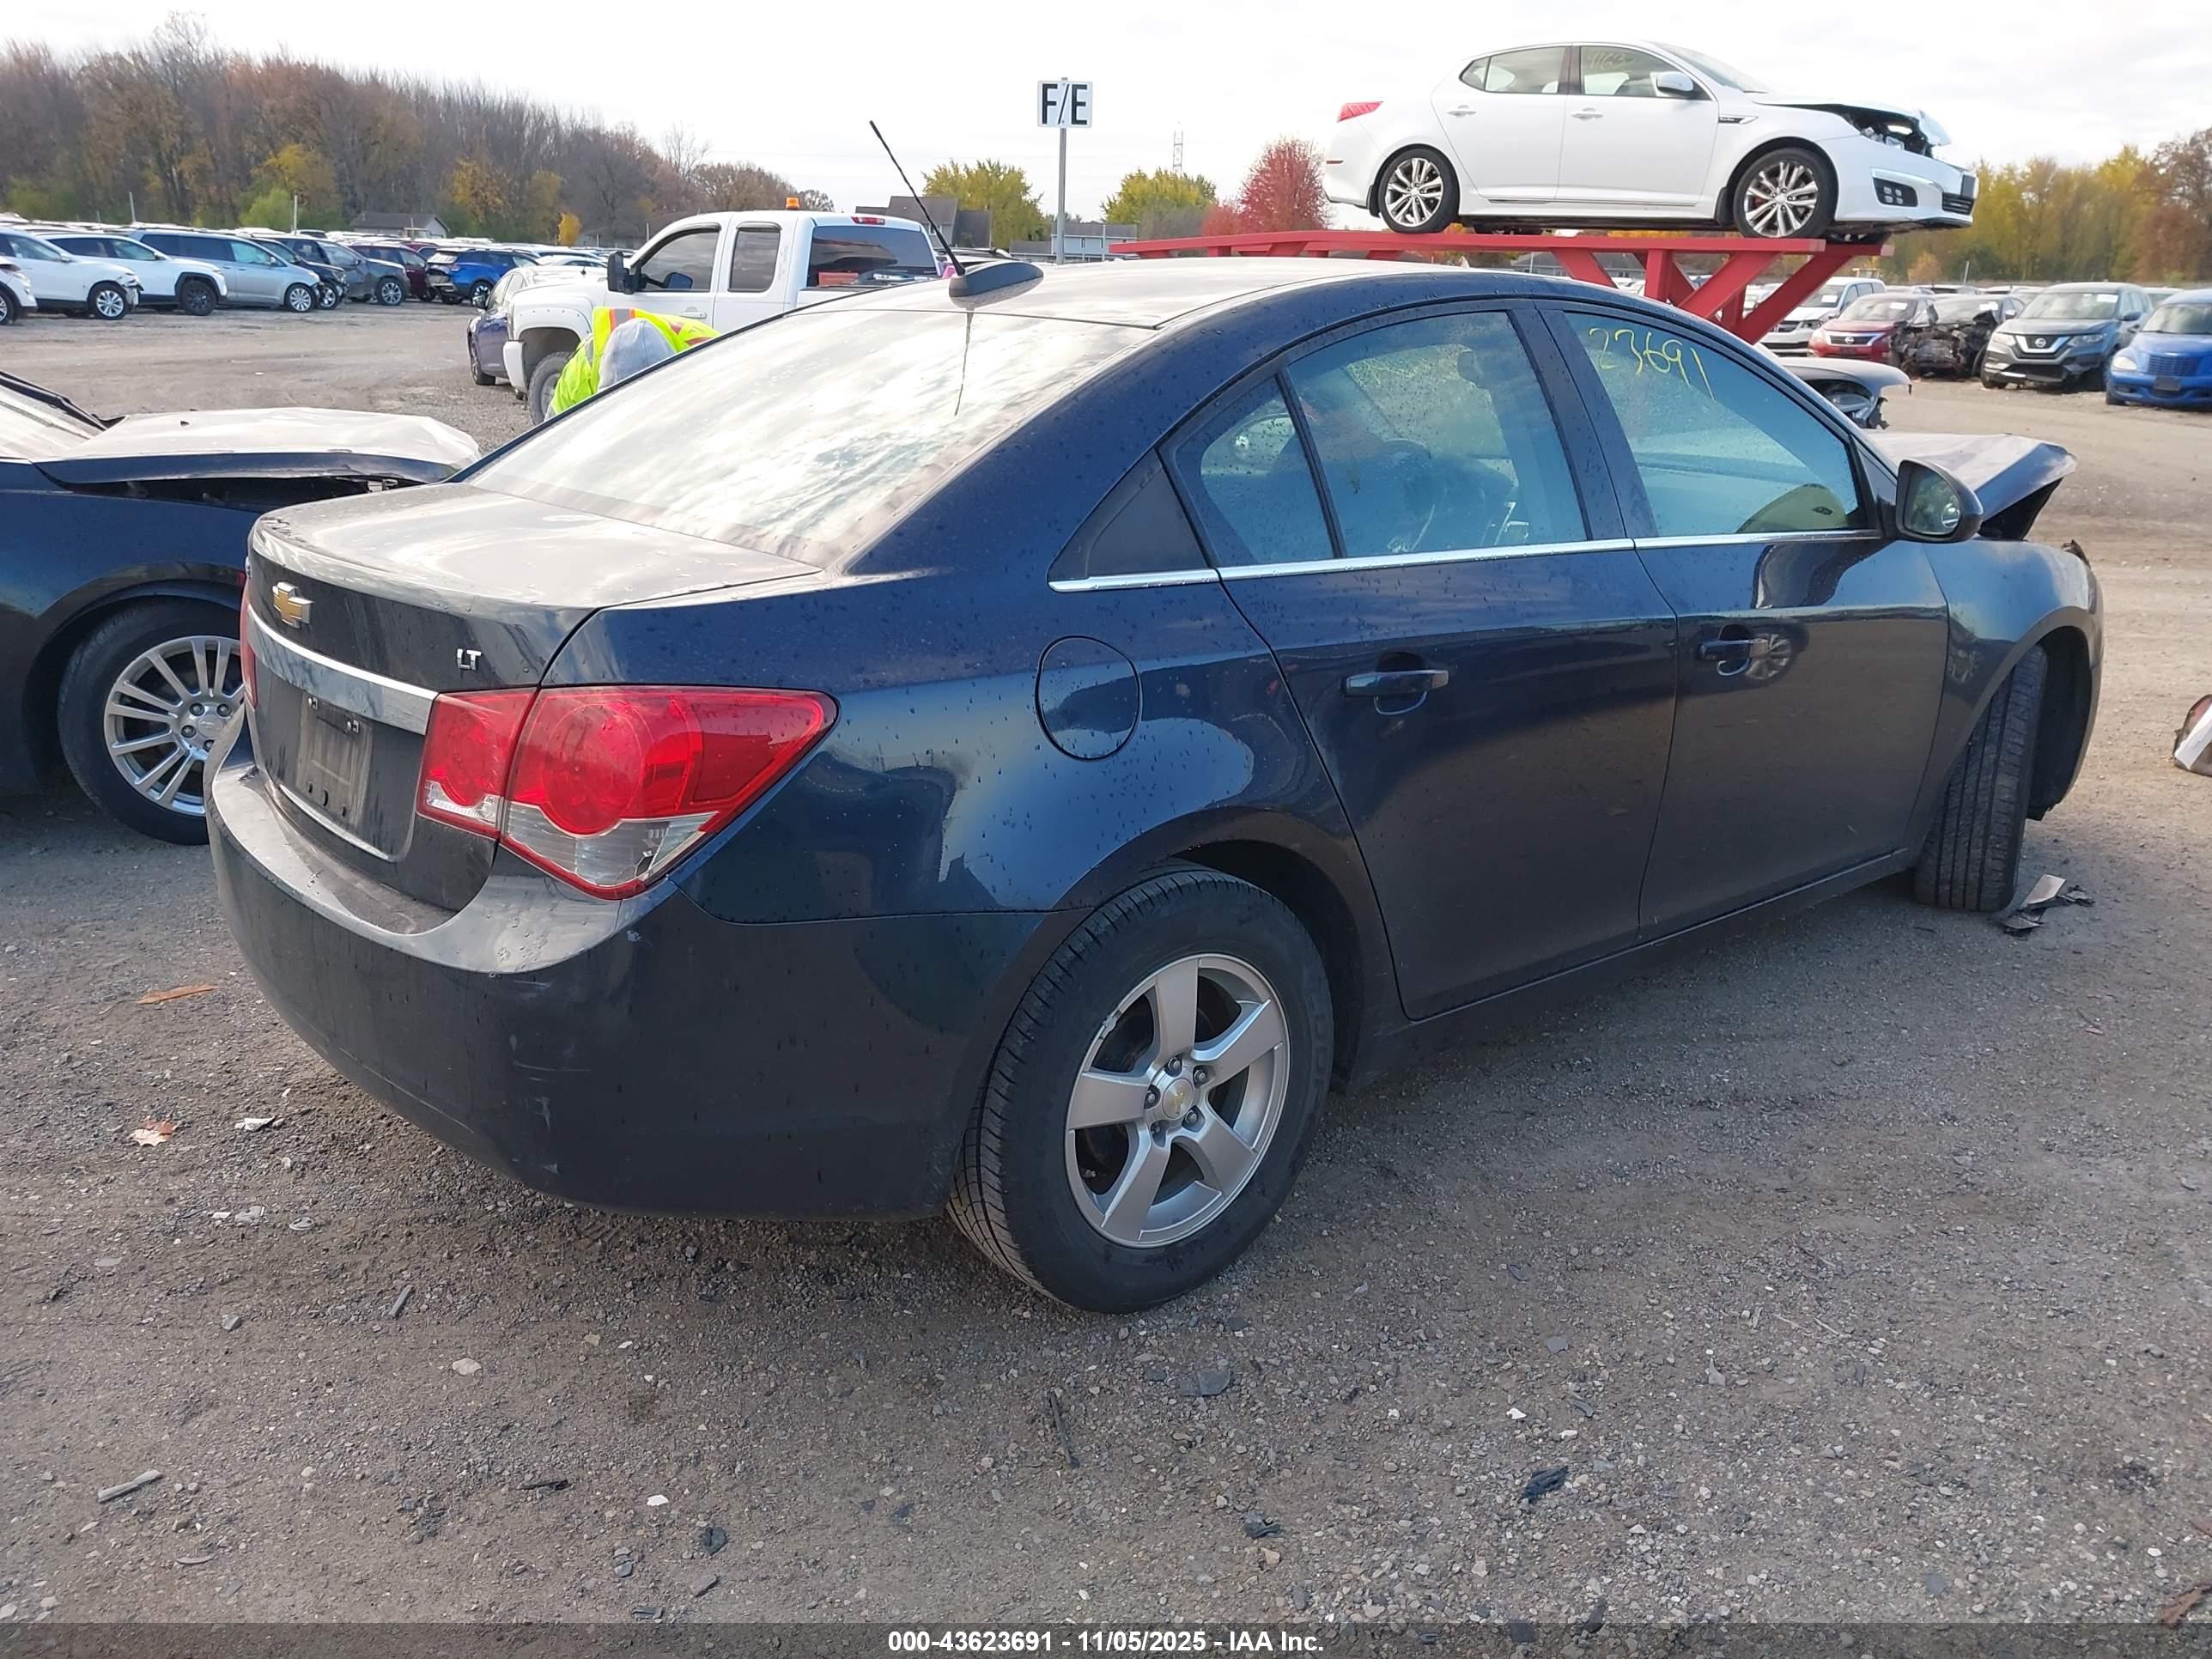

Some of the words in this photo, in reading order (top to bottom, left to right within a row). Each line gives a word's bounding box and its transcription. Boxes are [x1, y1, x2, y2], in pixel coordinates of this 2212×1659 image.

[1042, 83, 1088, 125] F/E
[1589, 327, 1716, 403] 23691
[456, 648, 482, 671] LT
